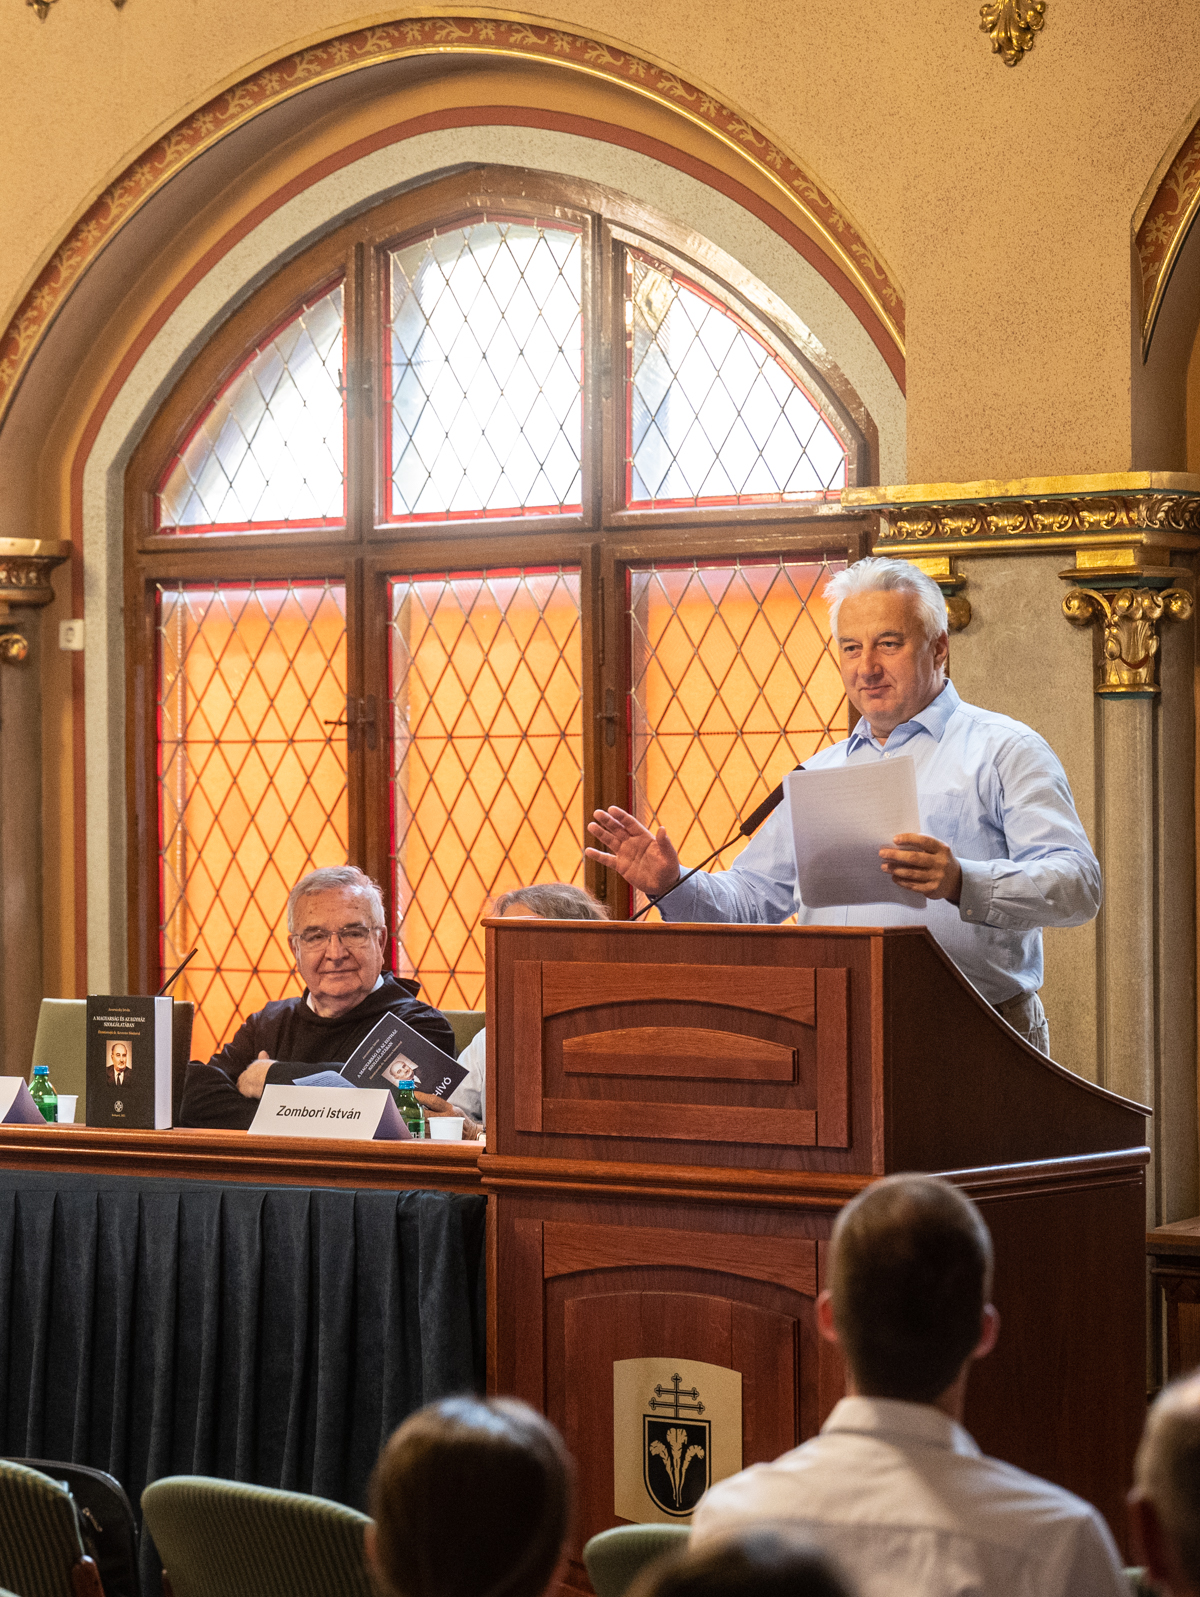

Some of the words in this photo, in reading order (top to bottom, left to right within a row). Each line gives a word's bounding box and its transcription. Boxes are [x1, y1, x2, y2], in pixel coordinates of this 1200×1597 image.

[432, 1076, 452, 1097] HÍVÓ
[275, 1104, 326, 1118] Zombori
[326, 1107, 362, 1120] István
